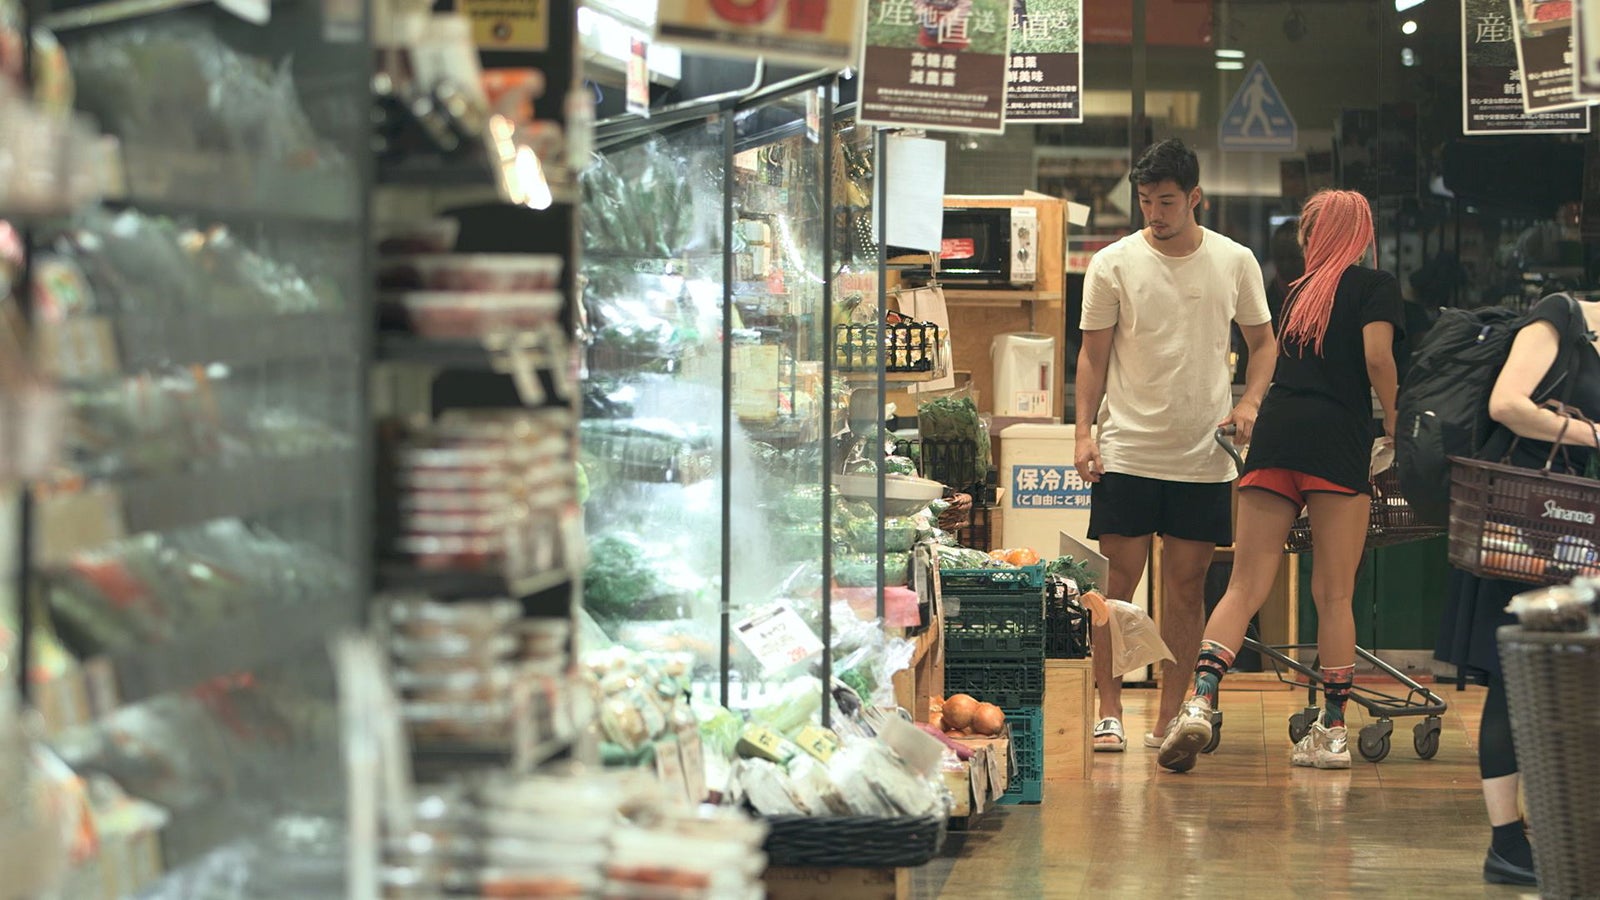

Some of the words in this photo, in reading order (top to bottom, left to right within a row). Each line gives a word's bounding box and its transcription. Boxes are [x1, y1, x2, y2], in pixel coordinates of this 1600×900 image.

[876, 0, 996, 44] 産地直送
[1009, 55, 1037, 69] 農薬
